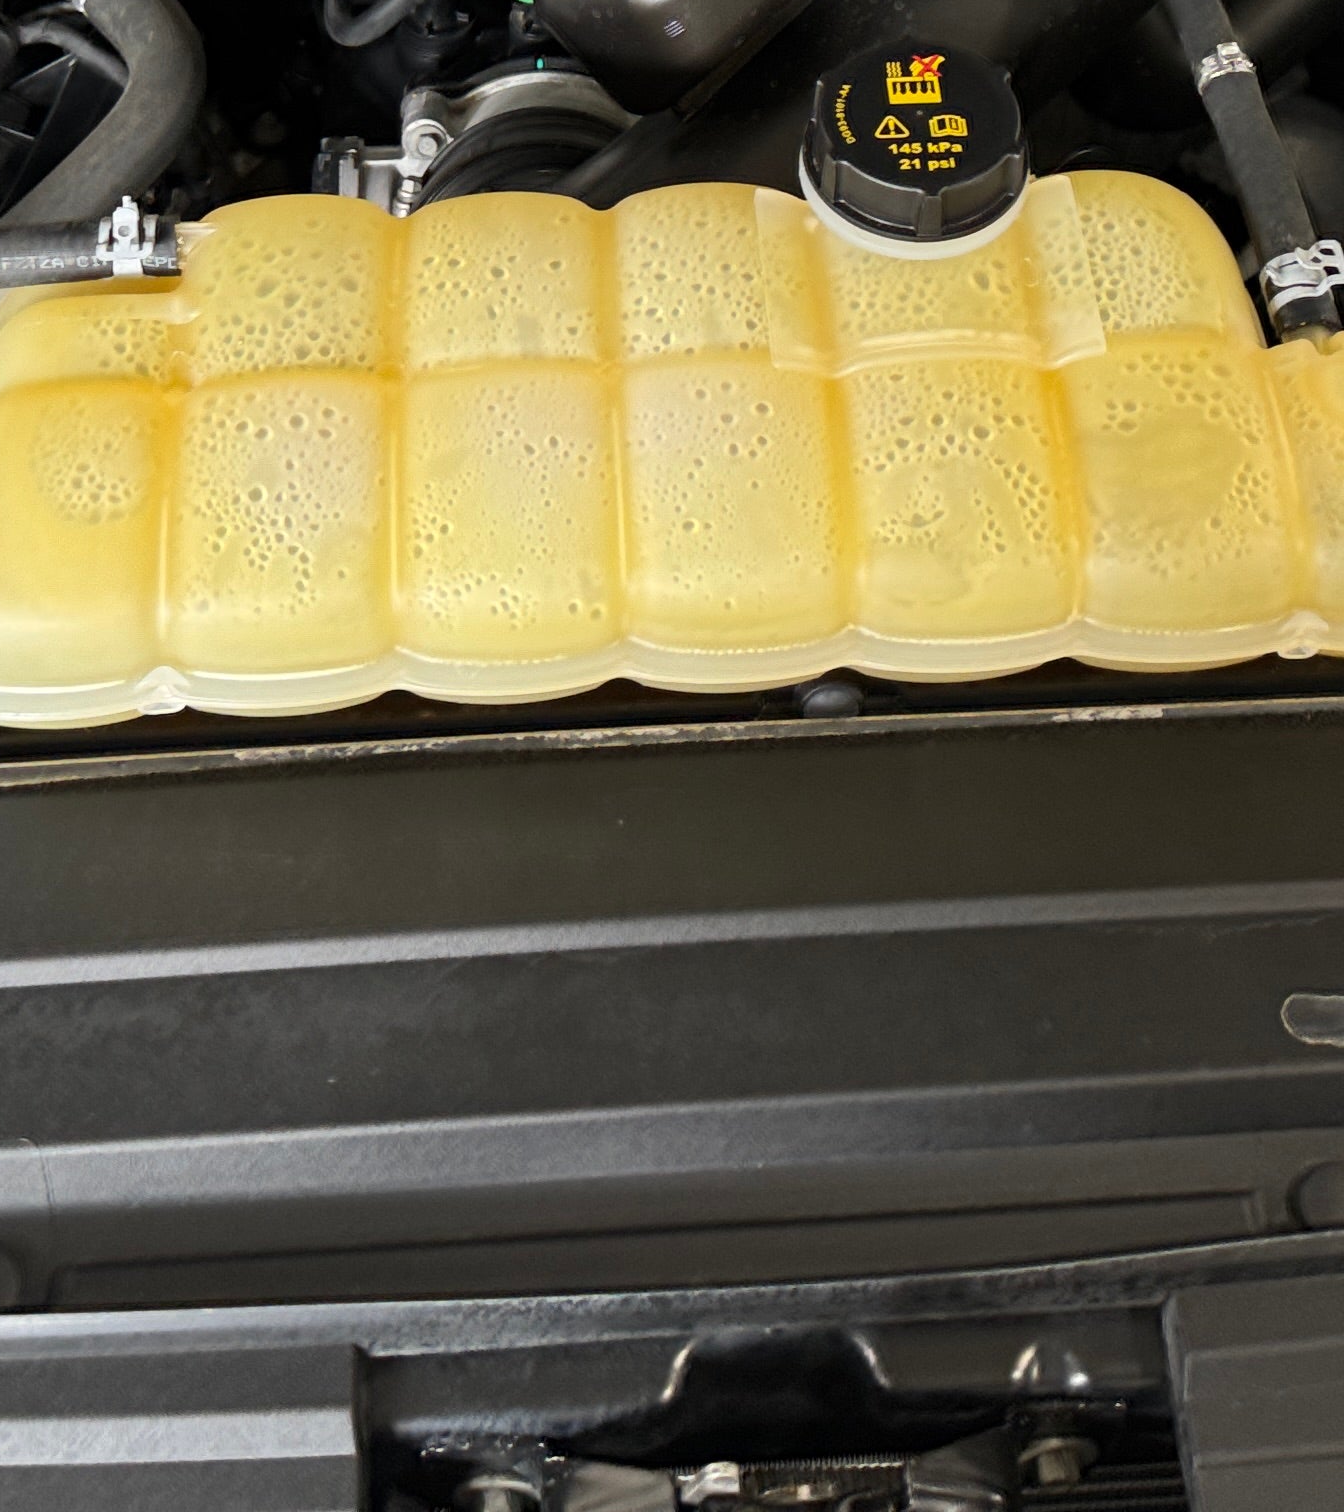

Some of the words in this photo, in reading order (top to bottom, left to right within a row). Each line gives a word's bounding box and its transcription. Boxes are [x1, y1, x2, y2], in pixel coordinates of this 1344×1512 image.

[888, 142, 923, 155] 145
[927, 141, 963, 154] kPa
[898, 158, 921, 170] 21
[927, 156, 956, 172] psi
